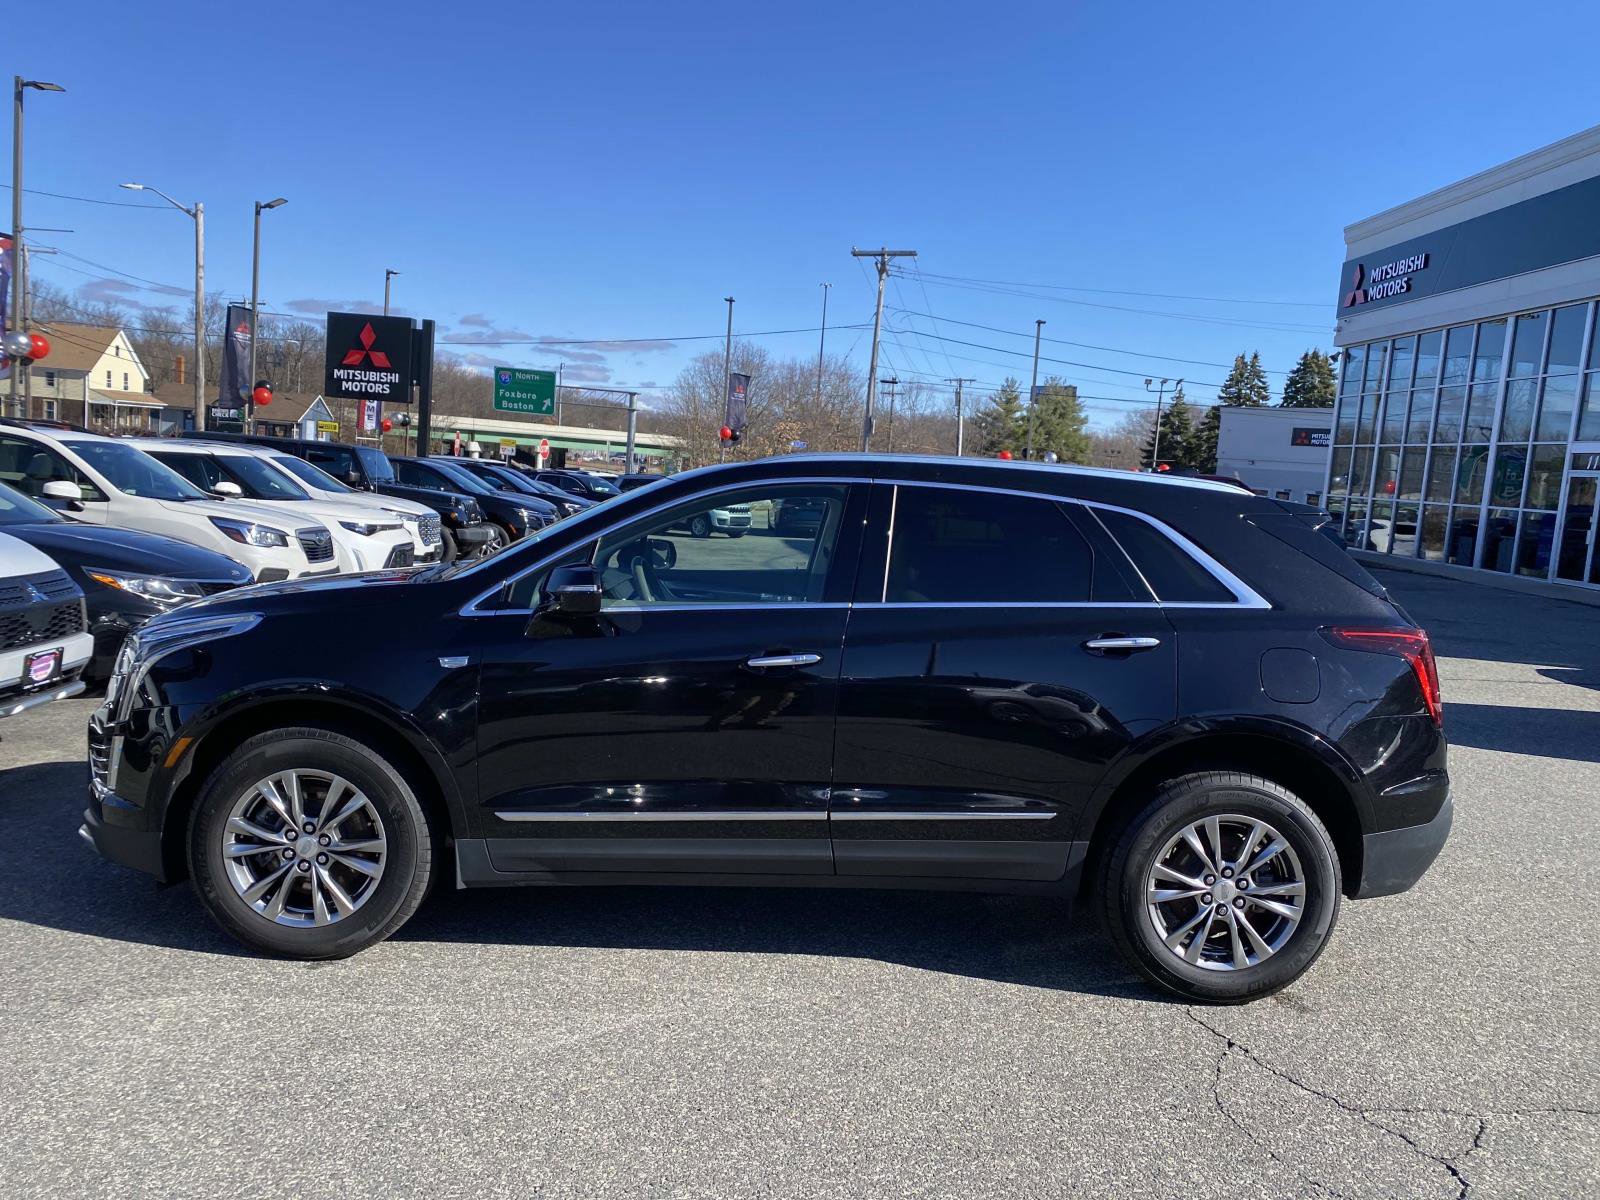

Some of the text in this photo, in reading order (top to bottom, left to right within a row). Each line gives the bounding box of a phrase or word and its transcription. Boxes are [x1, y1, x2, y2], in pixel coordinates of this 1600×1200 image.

[1370, 253, 1425, 283] MITSUBISHI
[1367, 277, 1408, 301] MOTORS
[333, 368, 399, 383] MITSUBISHI
[341, 381, 390, 394] MOTORS
[499, 389, 537, 400] Foxboro
[502, 400, 534, 411] Boston
